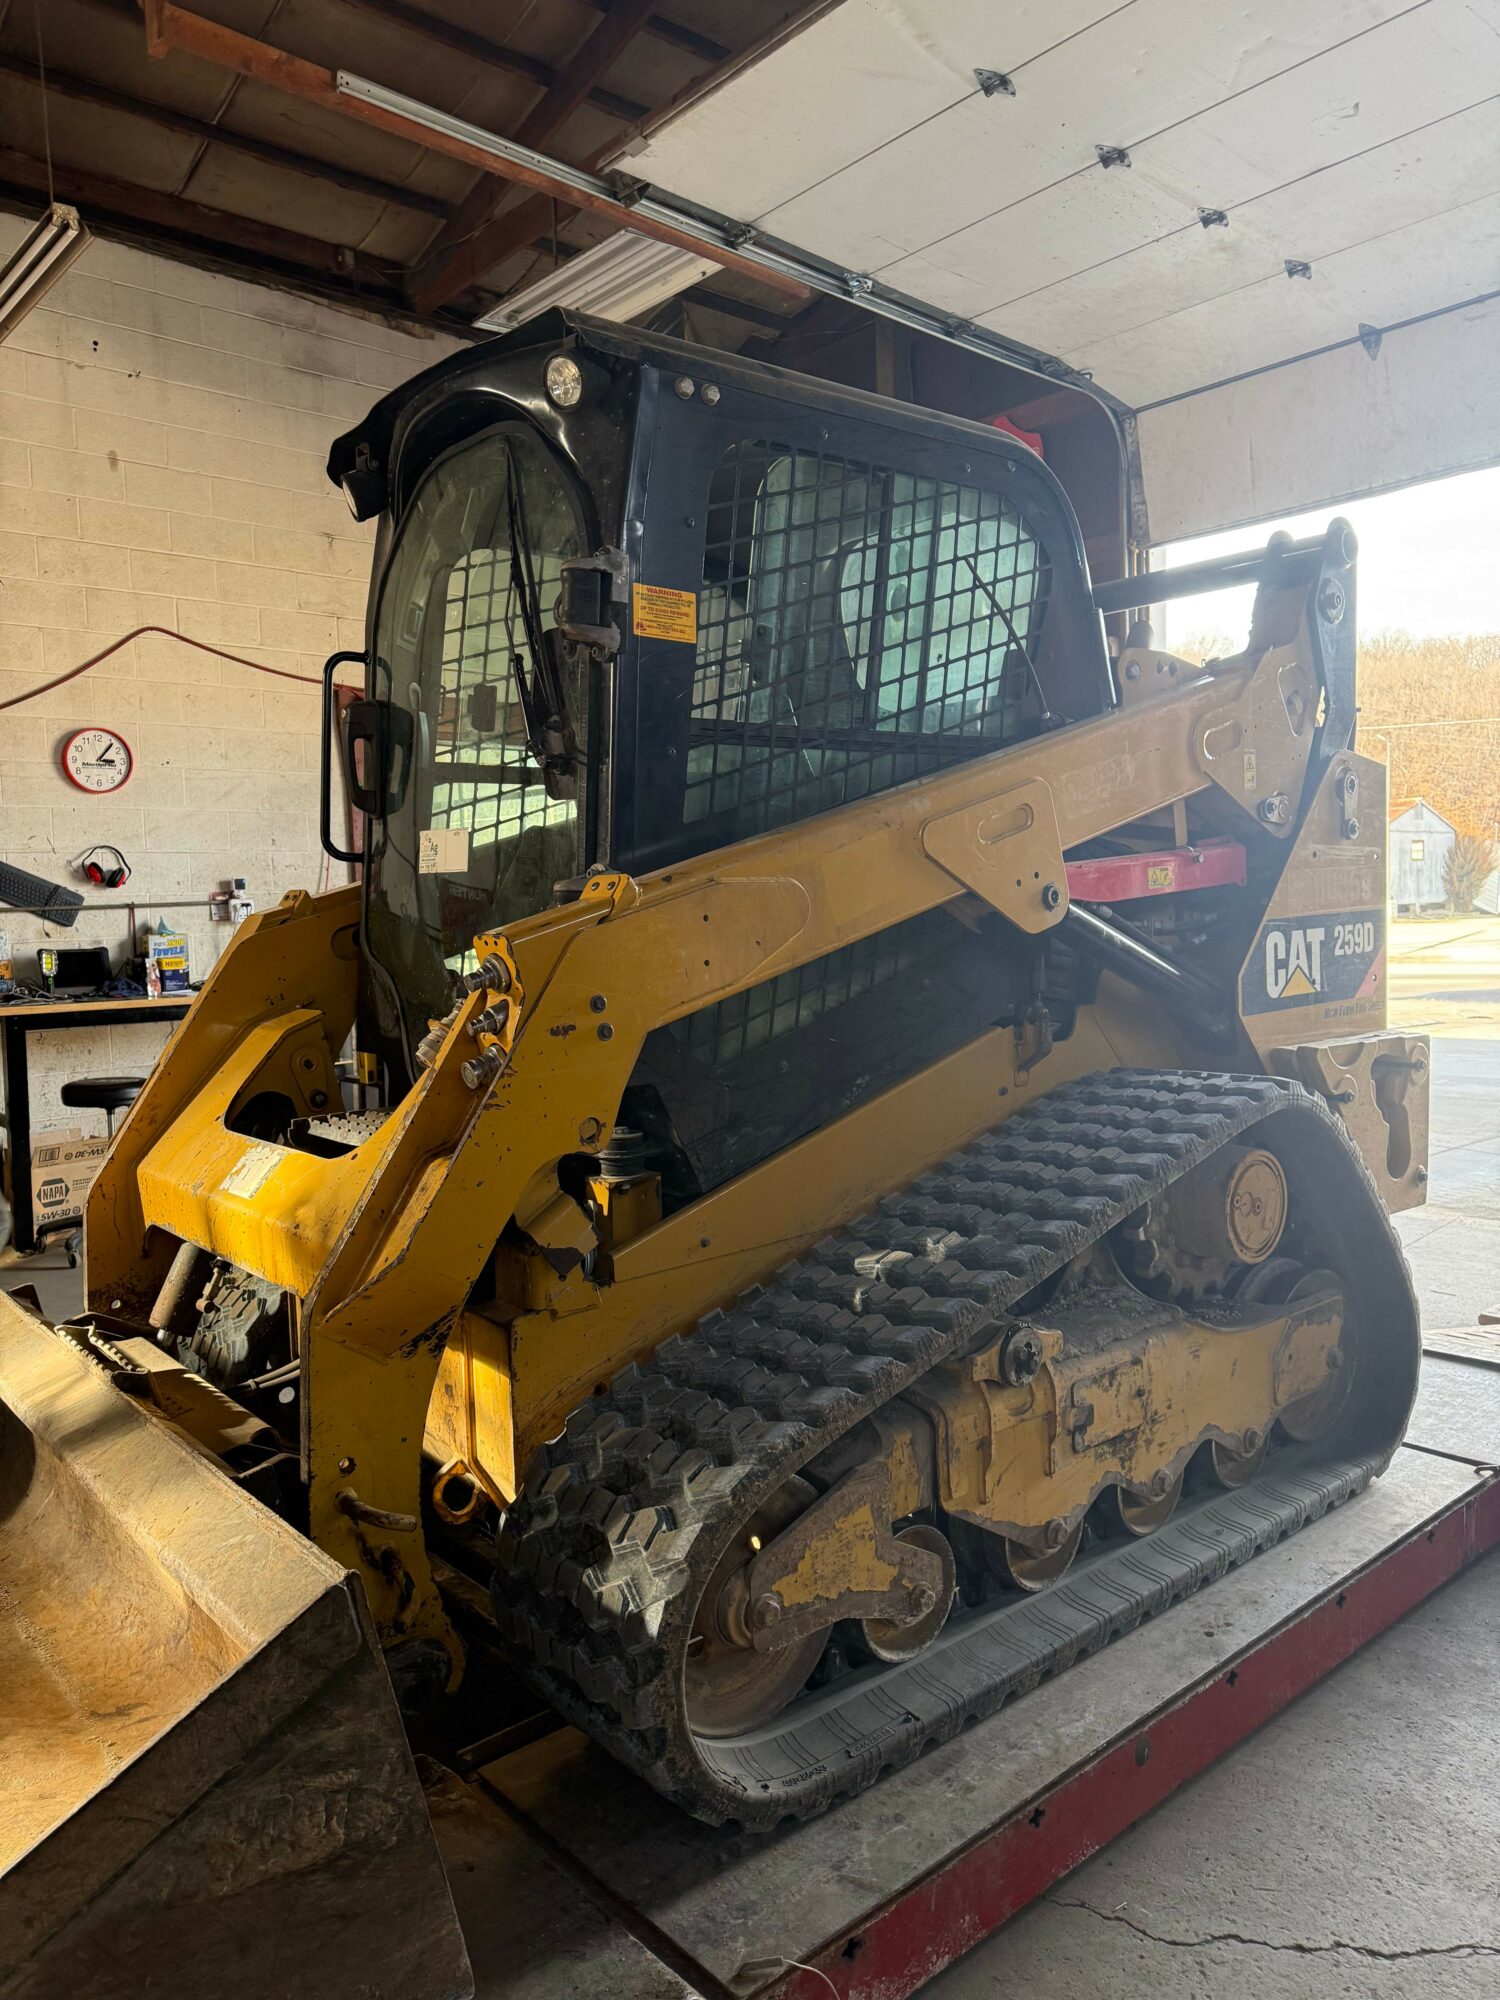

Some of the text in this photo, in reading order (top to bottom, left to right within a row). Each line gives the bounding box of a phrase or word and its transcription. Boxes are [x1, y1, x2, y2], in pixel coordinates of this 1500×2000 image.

[647, 587, 683, 598] WARNING
[82, 737, 90, 745] 11
[93, 734, 103, 743] 12
[74, 745, 83, 753] 10
[115, 747, 121, 755] 2
[71, 755, 77, 764] 9
[120, 757, 126, 766] 3
[75, 766, 82, 775] 8
[85, 775, 91, 783] 7
[96, 779, 103, 787] 6
[110, 776, 115, 784] 5
[1265, 921, 1375, 999] CAT 259D
[42, 1185, 64, 1201] NAPA
[40, 1208, 71, 1221] 5W-30
